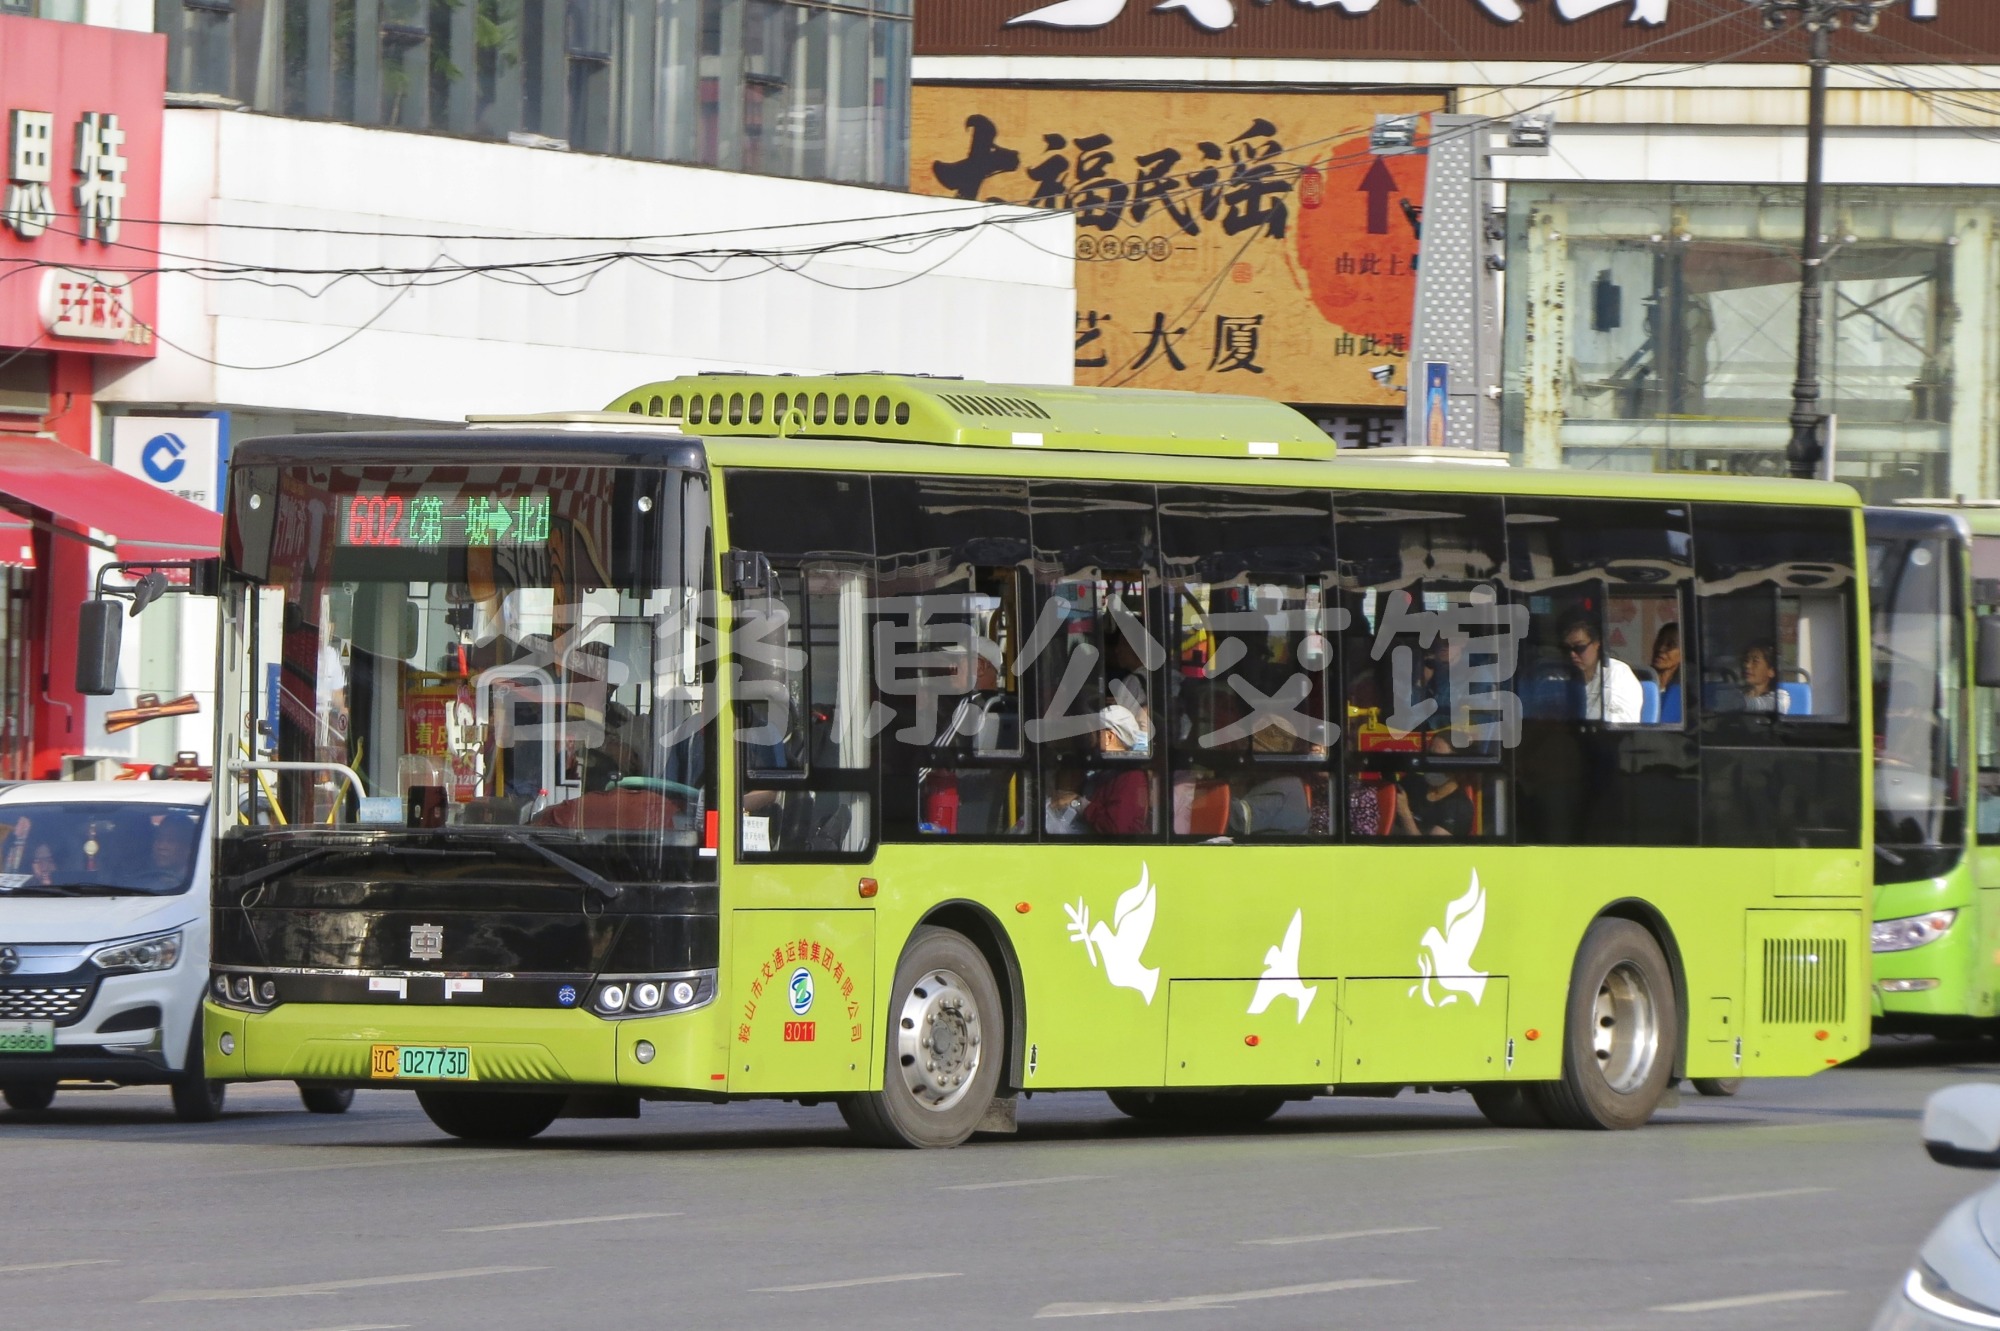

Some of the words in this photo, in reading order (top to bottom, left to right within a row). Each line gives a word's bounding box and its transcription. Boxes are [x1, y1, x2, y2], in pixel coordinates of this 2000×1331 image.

[350, 496, 403, 545] 602
[738, 939, 862, 1043] 鞍山市交通运输集团有限公司
[785, 1022, 815, 1041] 3011
